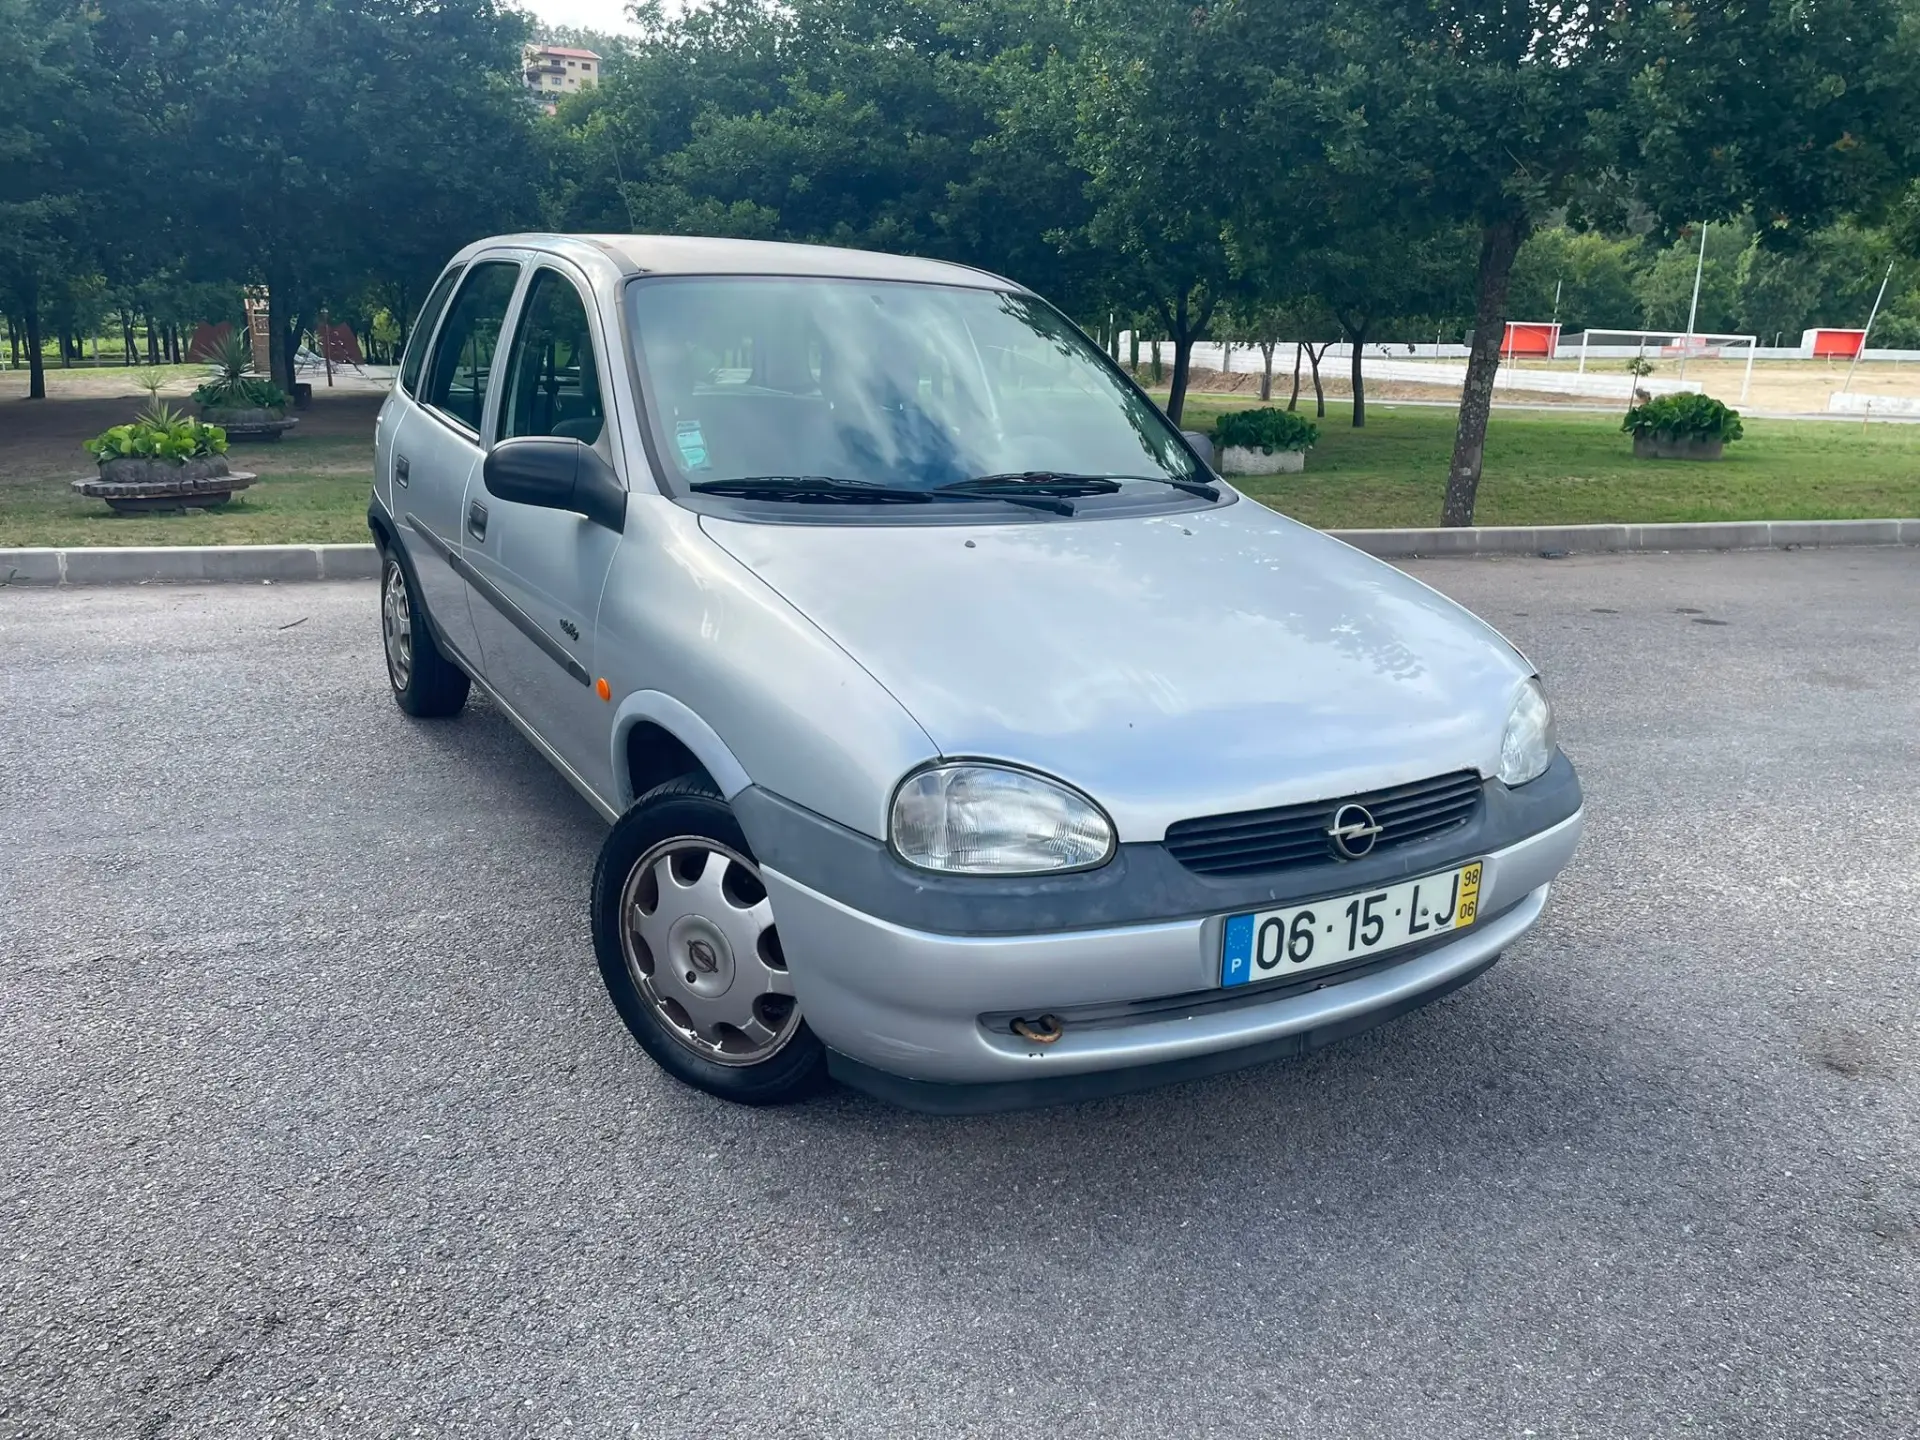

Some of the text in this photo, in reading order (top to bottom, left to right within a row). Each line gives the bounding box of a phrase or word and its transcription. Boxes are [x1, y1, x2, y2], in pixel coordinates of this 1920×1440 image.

[1463, 868, 1479, 887] 98
[1459, 901, 1475, 919] 06
[1231, 958, 1242, 974] P
